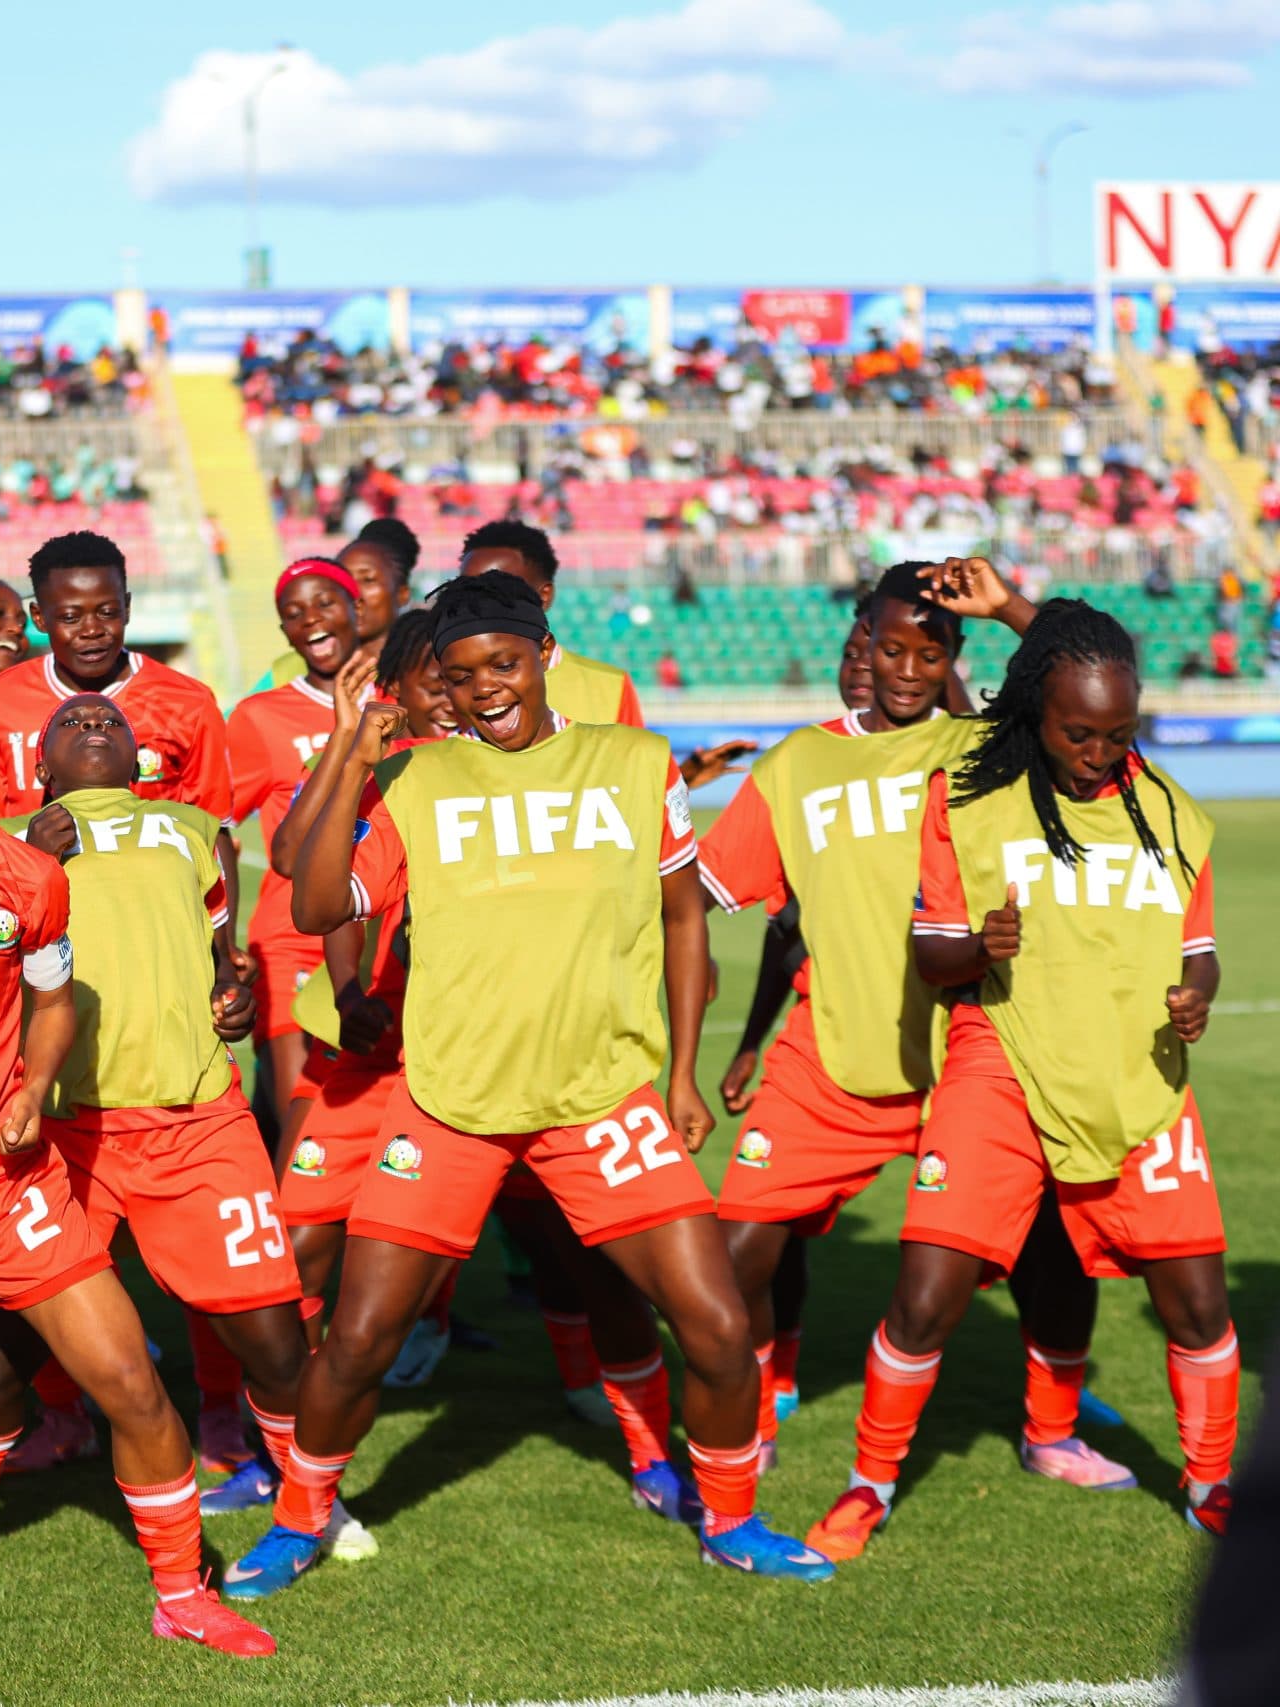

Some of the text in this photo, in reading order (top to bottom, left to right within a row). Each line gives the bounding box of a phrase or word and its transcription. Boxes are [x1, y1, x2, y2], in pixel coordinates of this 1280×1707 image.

[1107, 191, 1280, 271] NY
[434, 786, 635, 864] FIFA
[801, 770, 925, 855] FIF
[1002, 838, 1185, 914] FIFA
[585, 1105, 682, 1188] 22
[1139, 1116, 1210, 1193] 24
[12, 1186, 61, 1252] 2
[219, 1191, 284, 1268] 25
